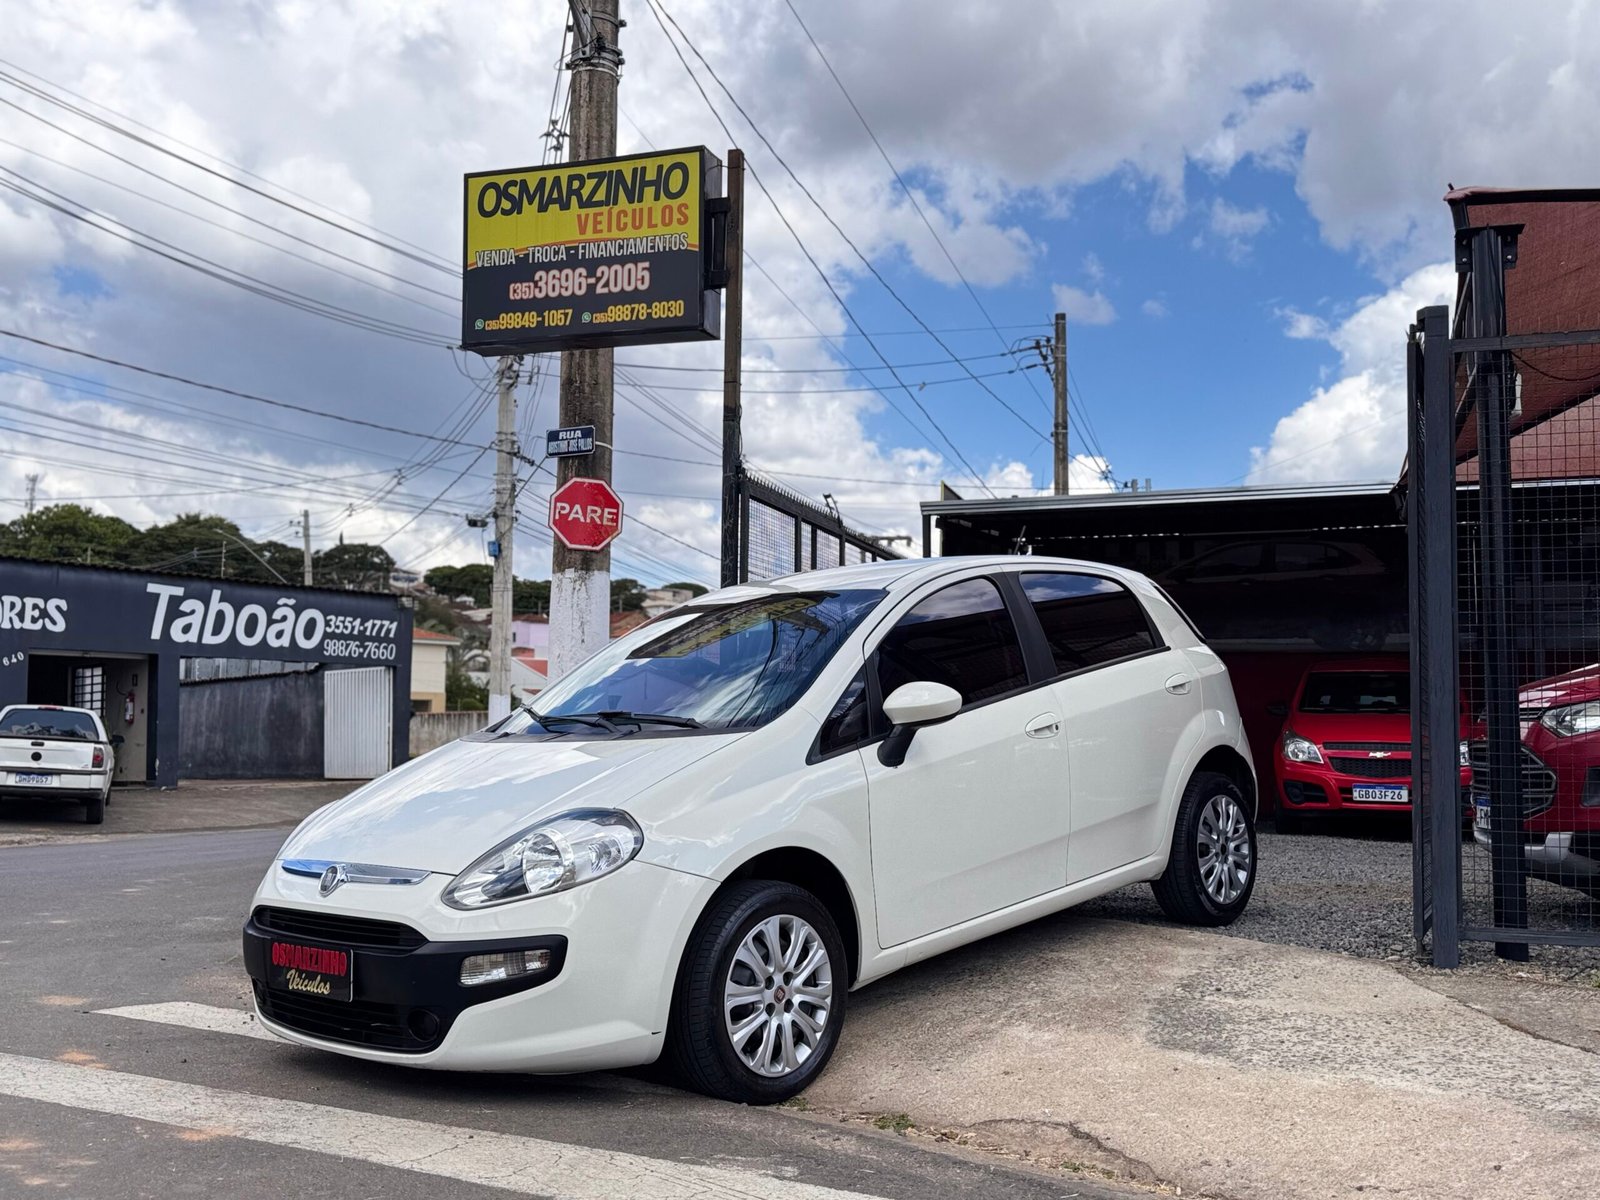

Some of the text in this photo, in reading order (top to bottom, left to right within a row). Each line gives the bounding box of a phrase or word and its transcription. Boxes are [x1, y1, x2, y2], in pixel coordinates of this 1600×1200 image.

[477, 161, 690, 218] OSMARZINHO
[576, 202, 689, 235] VEÍCULOS
[475, 248, 516, 268] VENDA
[527, 243, 567, 264] TROCA
[578, 232, 688, 260] FINANCIAMENTOS
[559, 430, 582, 440] RUA
[554, 502, 618, 527] PARE
[0, 595, 68, 633] RES
[145, 582, 326, 650] Taboão
[272, 942, 347, 977] OSMARZINHO
